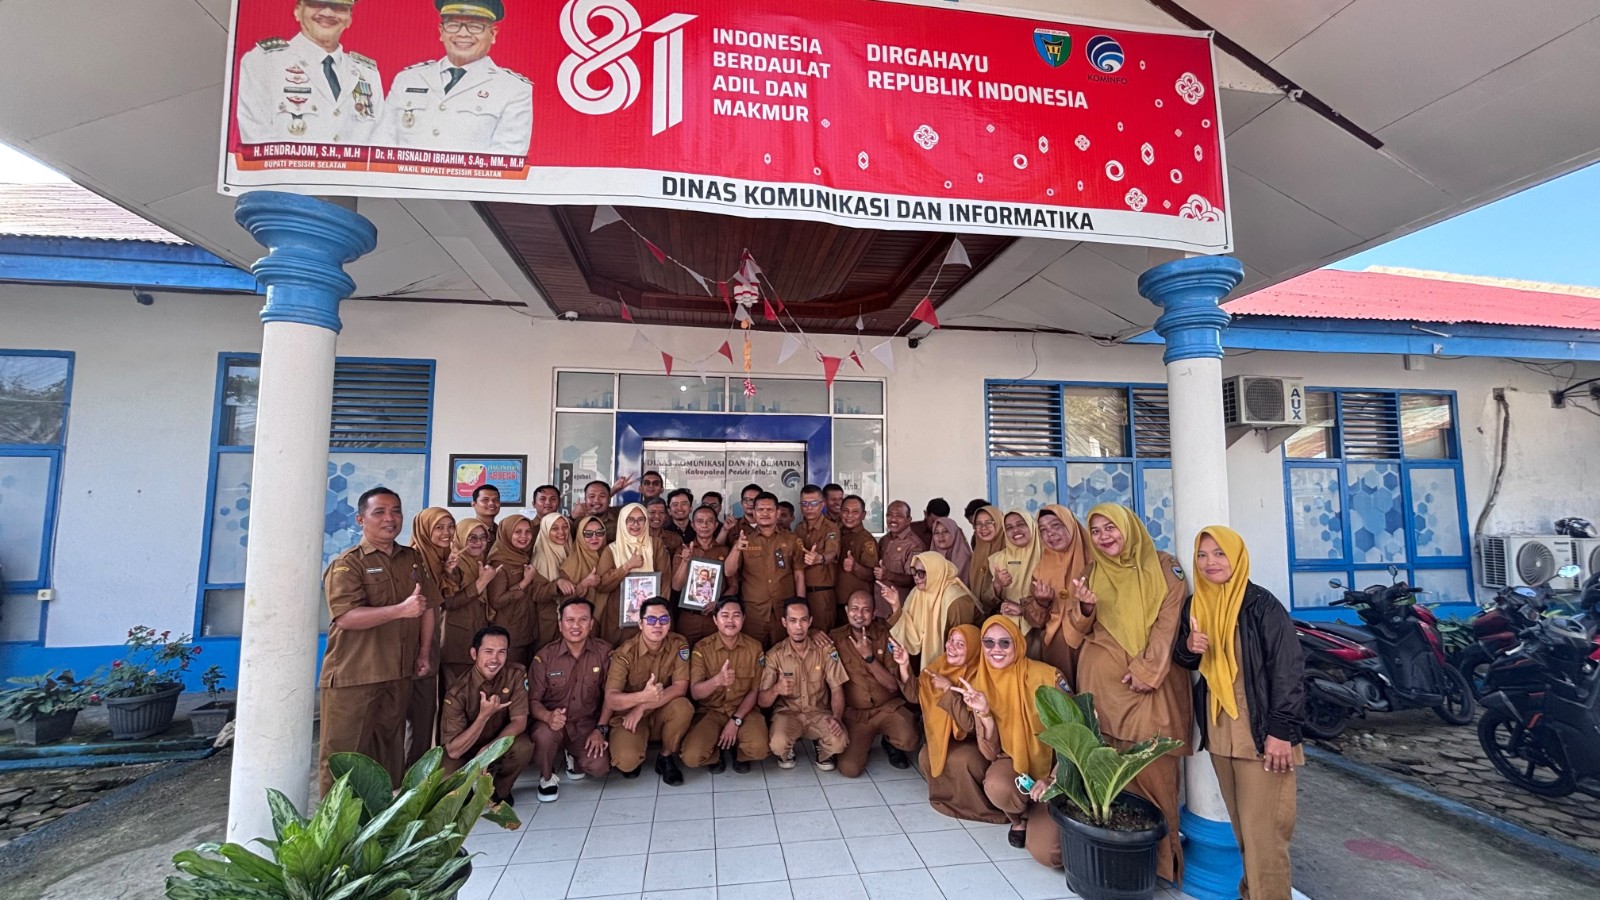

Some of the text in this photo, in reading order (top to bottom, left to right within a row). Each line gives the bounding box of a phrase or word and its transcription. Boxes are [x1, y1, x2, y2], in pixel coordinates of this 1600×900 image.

[712, 27, 823, 55] INDONESIA
[713, 51, 831, 79] BERDAULAT
[867, 43, 989, 73] DIRGAHAYU
[712, 75, 807, 99] ADIL DAN
[867, 70, 1089, 109] REPUBLIK INDONESIA
[1087, 74, 1128, 85] KOMINFO
[713, 98, 809, 123] MAKMUR
[253, 144, 361, 159] H. HENDRAJONI, S.H., M.H
[375, 148, 525, 168] Dr. H. RISNALDI IBRAHIM, S.Ag., MM., M.H
[264, 160, 347, 169] BUPATI PESISIR SELATAN
[397, 165, 502, 178] WAKIL BUPATI PESISIR SELATAN
[662, 175, 1095, 231] DINAS KOMUNIKASI DAN INFORMATIKA
[1290, 388, 1302, 420] AUX
[685, 468, 725, 476] Kabupaten
